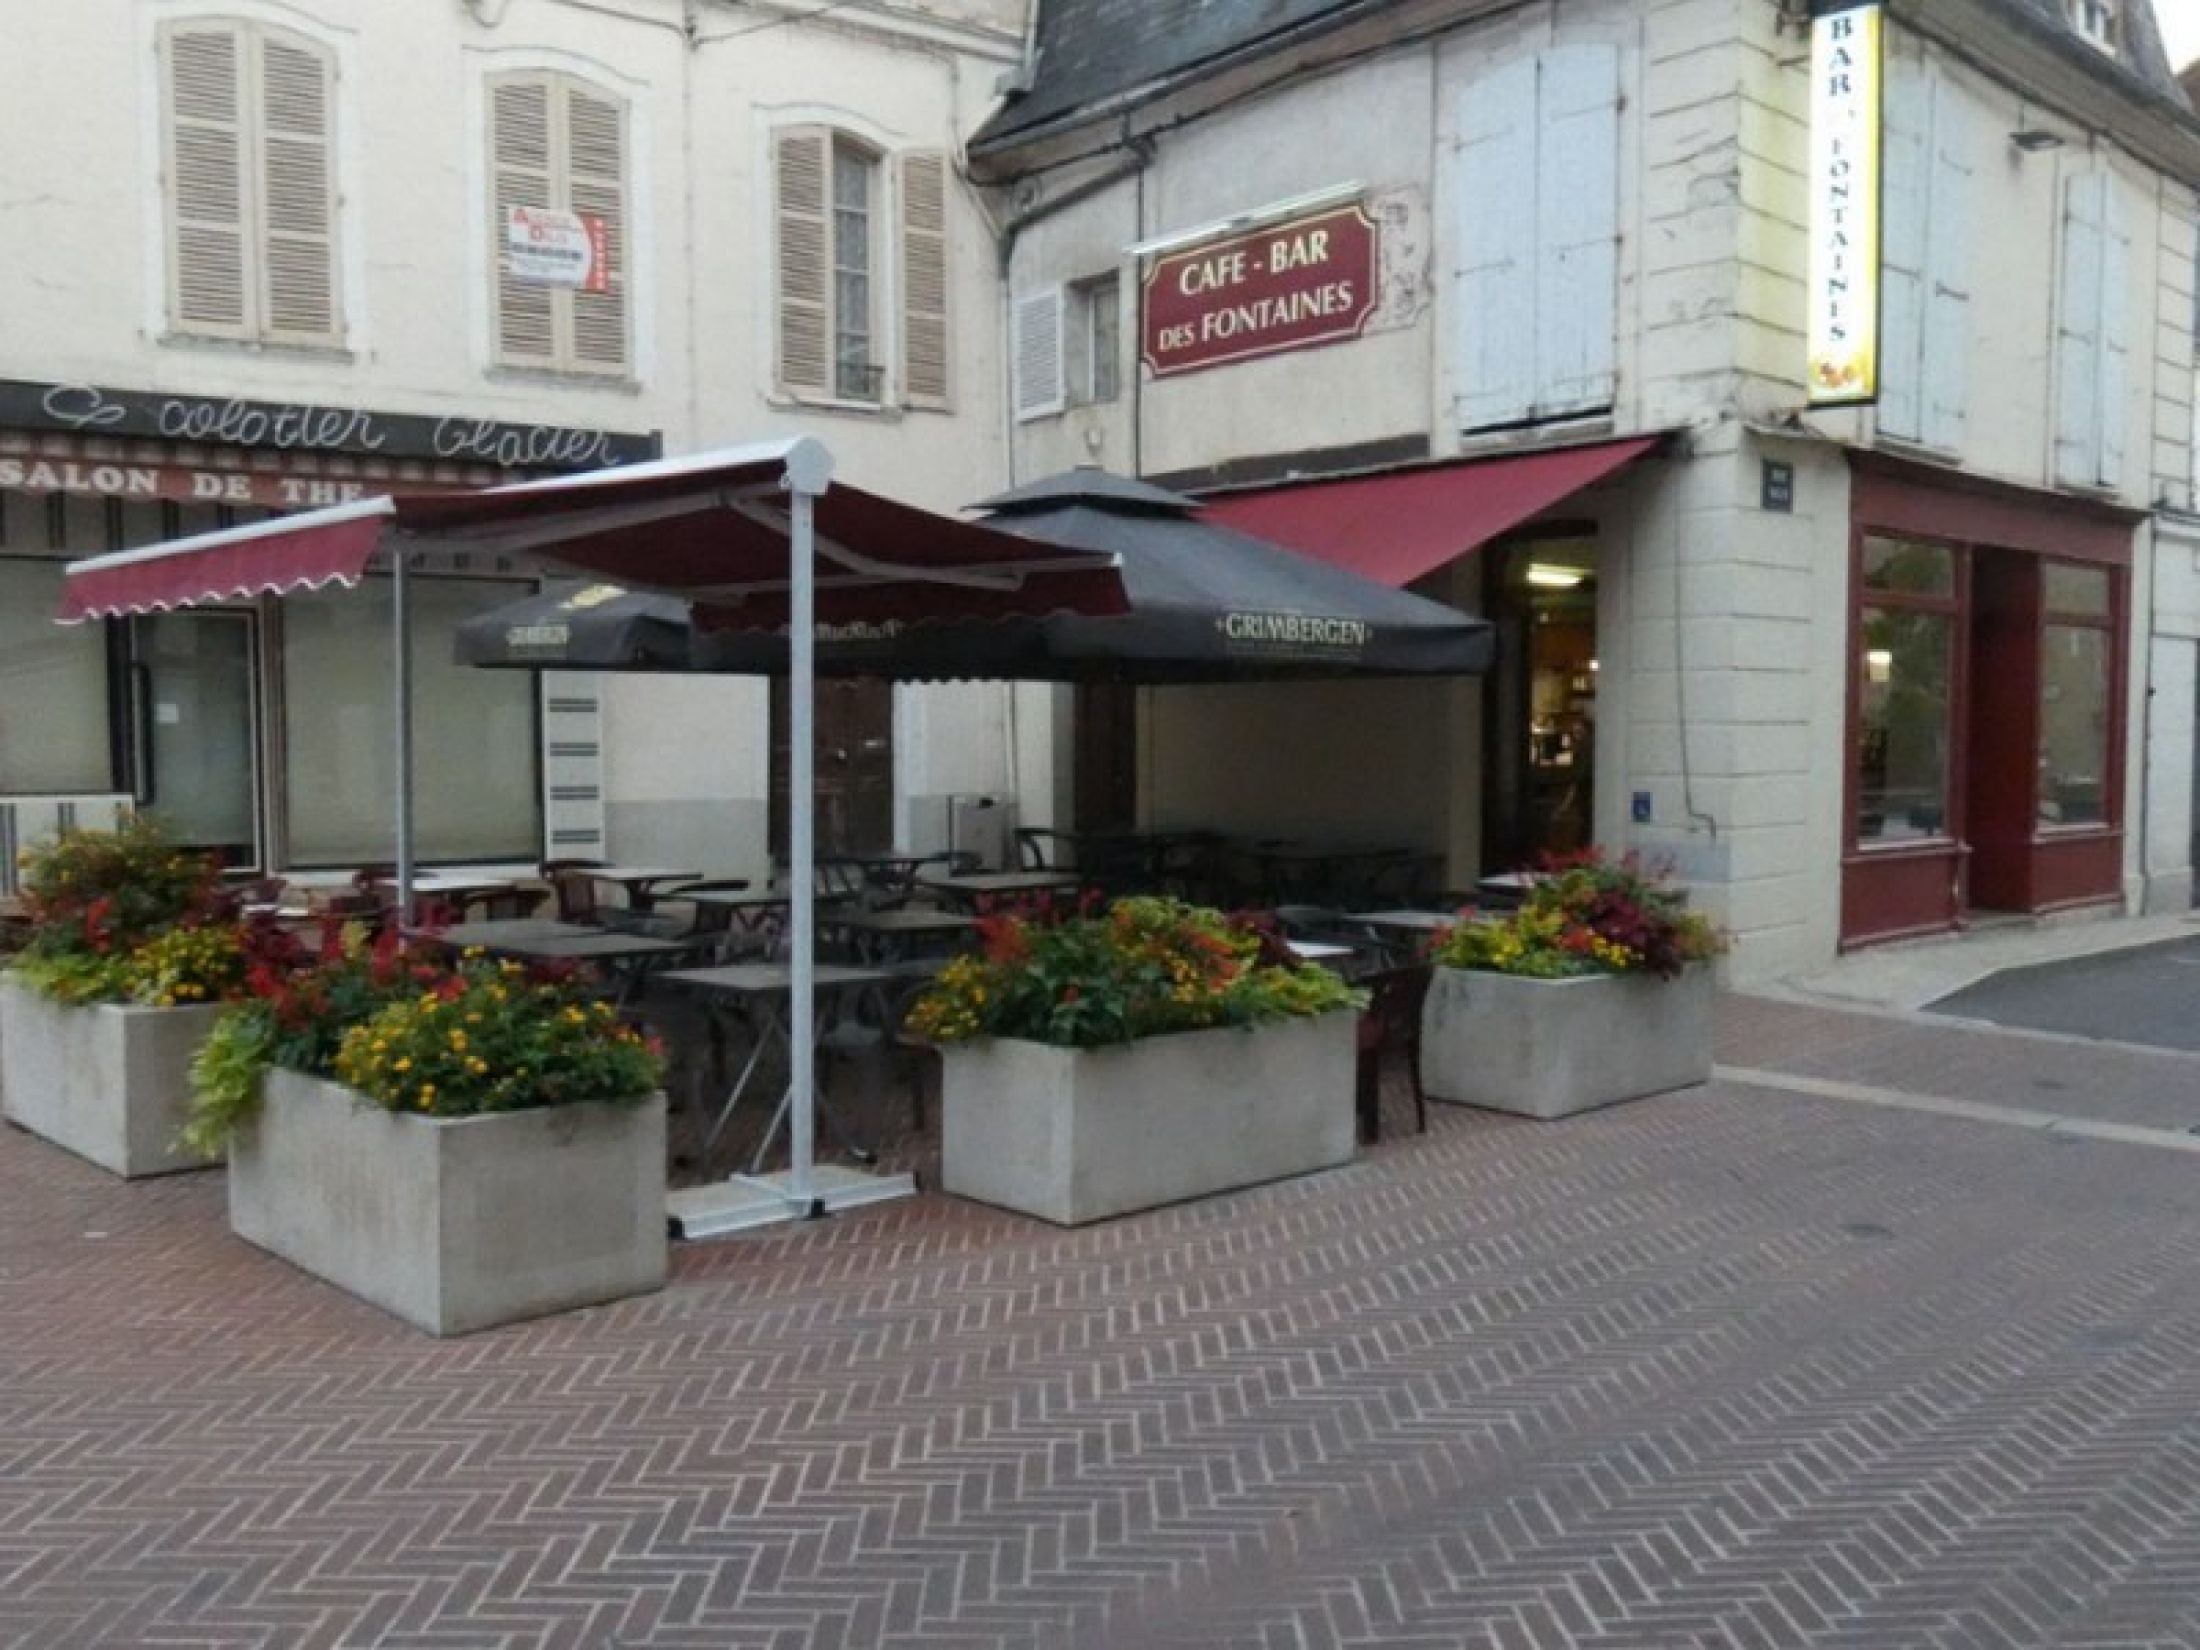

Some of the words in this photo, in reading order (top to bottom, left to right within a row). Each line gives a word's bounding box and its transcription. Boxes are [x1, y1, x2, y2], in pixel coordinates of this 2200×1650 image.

[1828, 15, 1853, 97] BAR
[1178, 252, 1247, 296] CAFE
[1269, 229, 1329, 274] BAR
[1201, 280, 1354, 343] FONTAINES
[0, 457, 158, 494] SALON
[192, 473, 251, 499] DE
